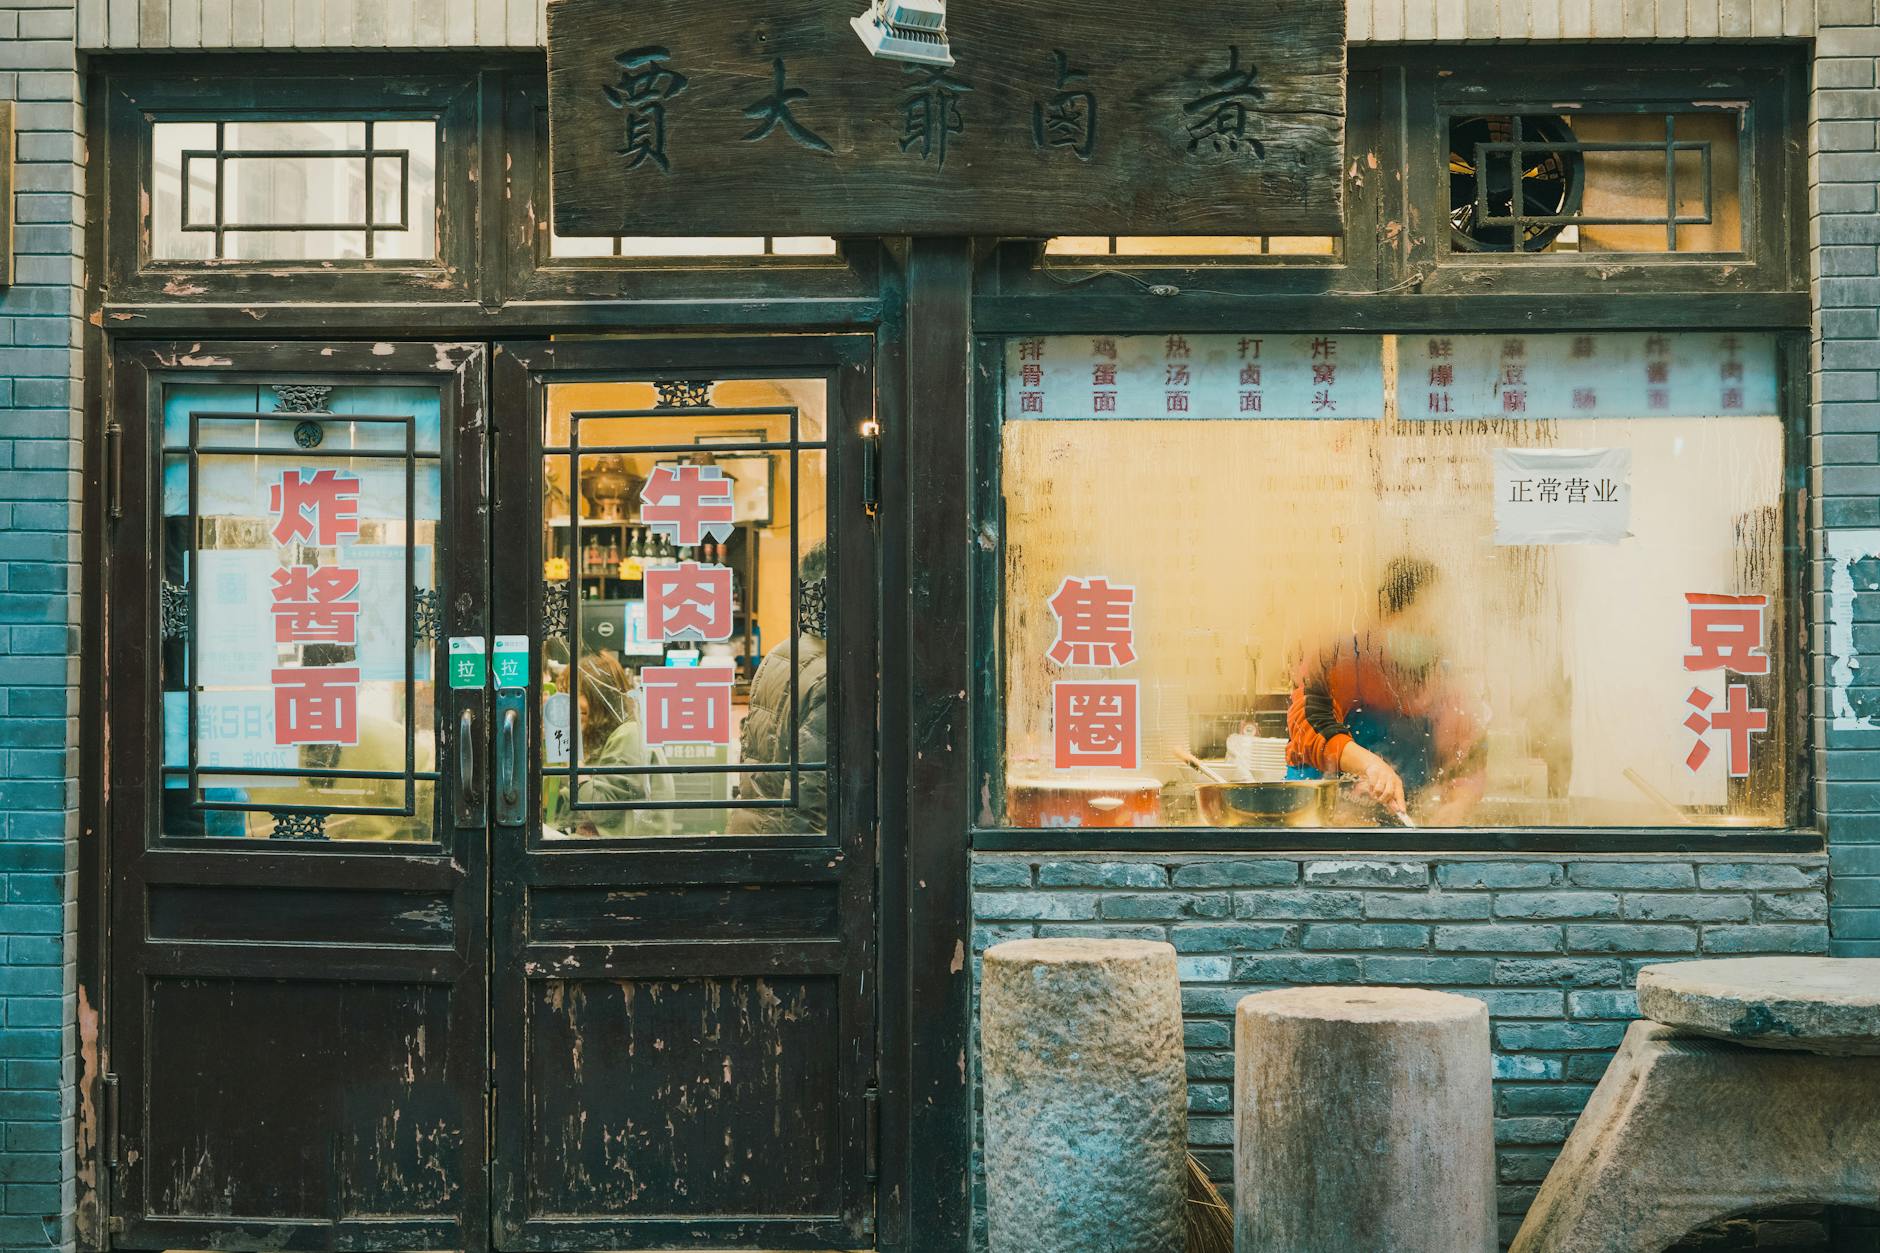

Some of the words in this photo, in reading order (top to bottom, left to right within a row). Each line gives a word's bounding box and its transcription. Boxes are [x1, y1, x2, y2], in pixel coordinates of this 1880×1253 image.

[1019, 337, 1045, 413] 排骨面
[1092, 338, 1118, 413] 鸡蛋面
[1165, 335, 1191, 412] 热汤面
[1237, 337, 1264, 412] 打卤面
[1311, 337, 1337, 412] 炸窝头
[1508, 477, 1619, 504] 正常营业
[269, 467, 361, 747] 炸酱面
[641, 465, 735, 748] 牛肉面
[458, 660, 475, 678] 拉
[501, 659, 519, 677] 拉
[1046, 576, 1140, 770] 焦圈
[1683, 592, 1770, 777] 豆汁
